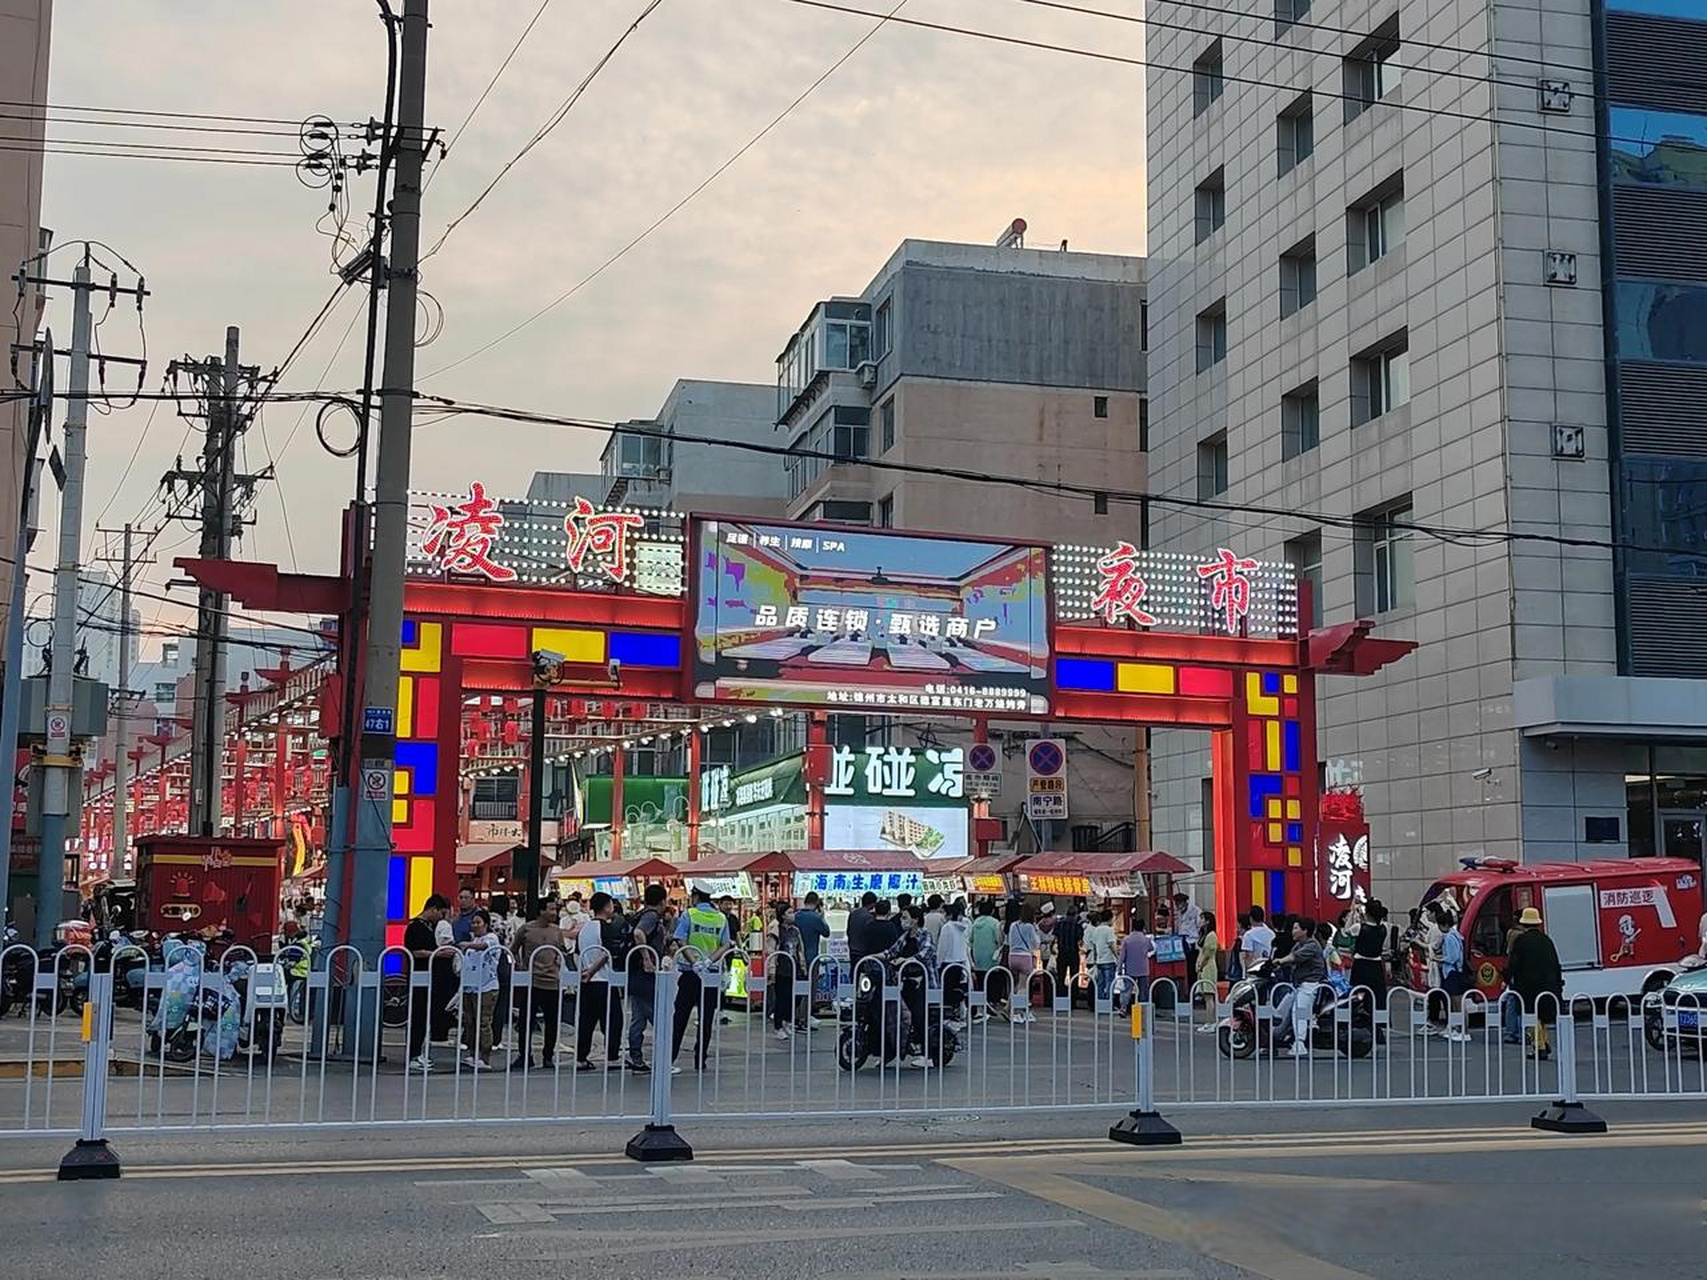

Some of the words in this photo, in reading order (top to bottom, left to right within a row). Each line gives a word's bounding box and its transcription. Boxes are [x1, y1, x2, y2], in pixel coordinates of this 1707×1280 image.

[790, 537, 813, 550] 按摩
[822, 540, 845, 552] SPA
[421, 480, 644, 583] 凌河
[1091, 541, 1259, 633] 夜市
[1032, 795, 1063, 807] 南宁路
[1328, 832, 1353, 900] 凌河
[1603, 890, 1655, 906] 消防巡逻
